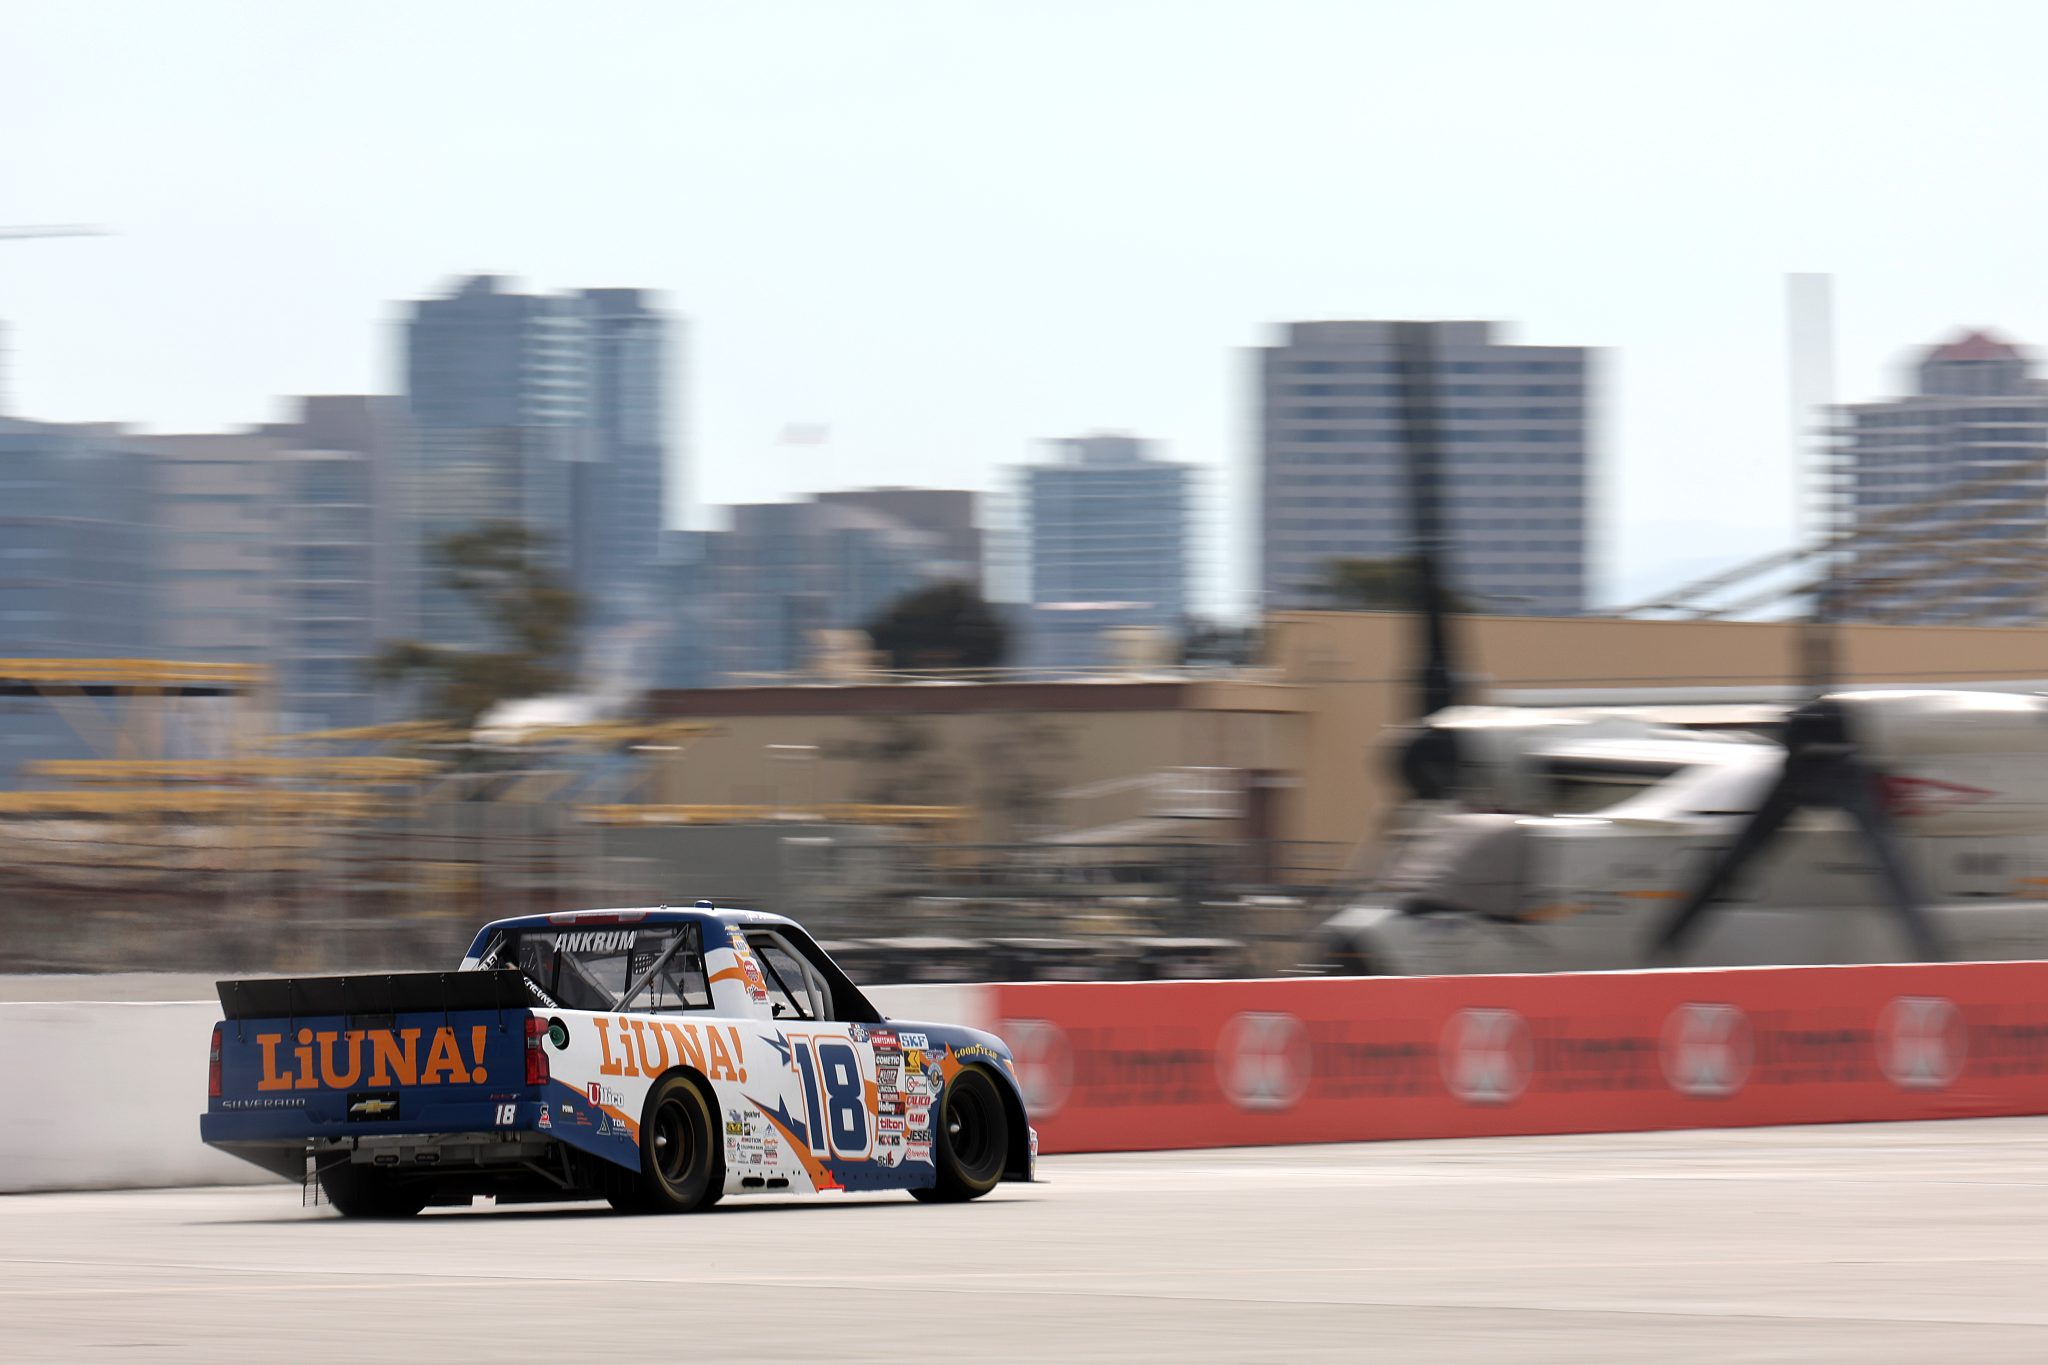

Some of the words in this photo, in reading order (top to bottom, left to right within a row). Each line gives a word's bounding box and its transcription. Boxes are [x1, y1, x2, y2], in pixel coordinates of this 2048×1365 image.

[553, 930, 637, 953] ANKRUM
[872, 1034, 897, 1046] CRAFTSMAN
[901, 1034, 927, 1049] SKF
[593, 1016, 747, 1085] LiUNA!
[256, 1025, 488, 1092] LiUNA!
[876, 1054, 900, 1067] COMETIC
[879, 1069, 898, 1081] KLOTZ
[587, 1082, 625, 1107] Ullico
[787, 1033, 873, 1161] 18
[906, 1095, 931, 1106] CALICO
[222, 1097, 306, 1109] SILVERADO
[878, 1101, 896, 1115] Holley
[495, 1104, 516, 1126] 18
[880, 1118, 904, 1129] tilton
[878, 1135, 900, 1147] KOOKS
[906, 1129, 932, 1142] JESEL
